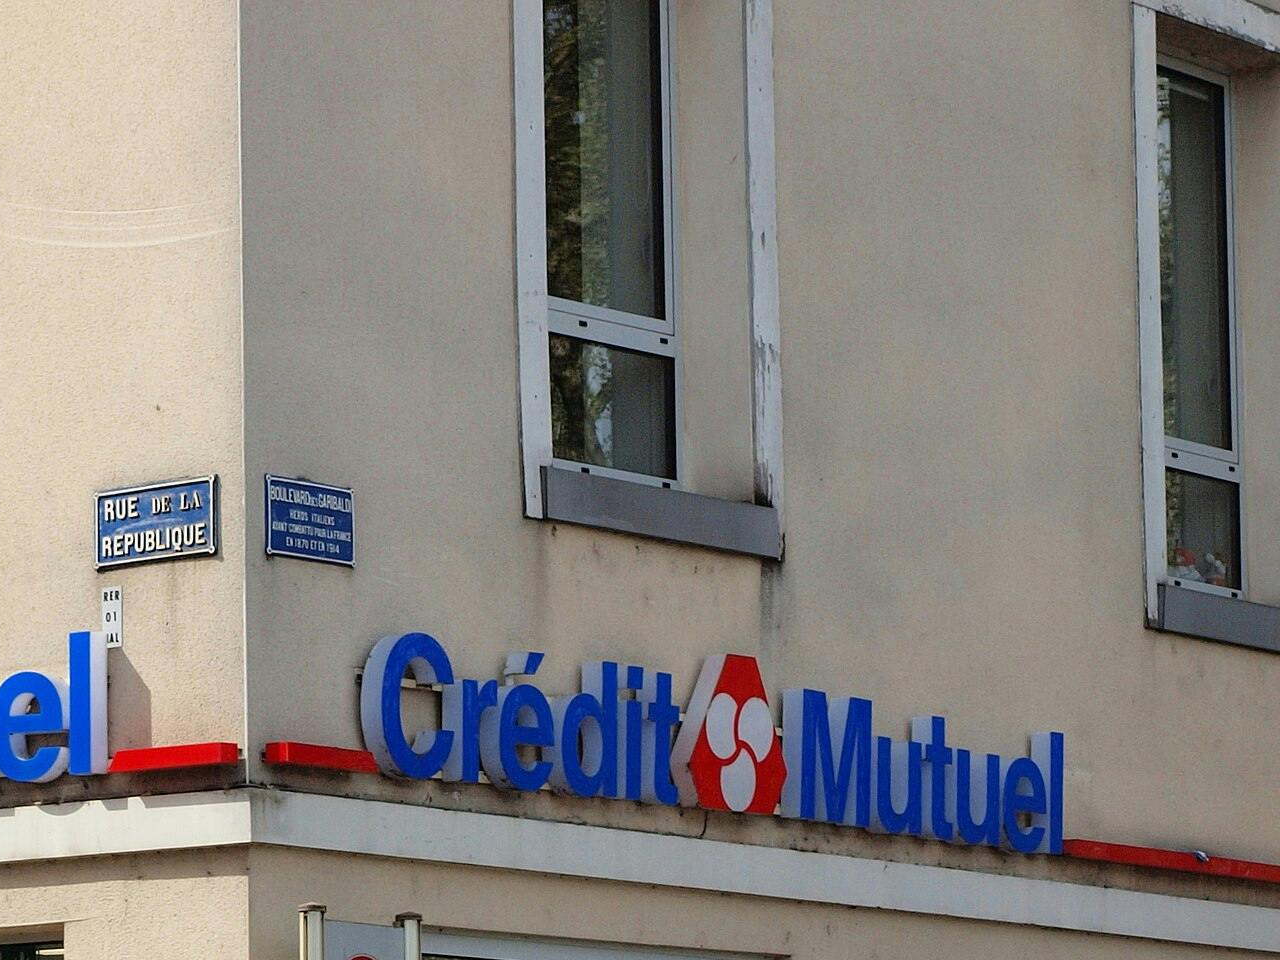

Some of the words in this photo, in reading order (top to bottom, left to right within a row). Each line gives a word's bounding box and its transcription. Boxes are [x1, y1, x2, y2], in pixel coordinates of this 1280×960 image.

[104, 497, 138, 521] RUE
[151, 495, 172, 515] DE
[179, 490, 202, 510] LA
[270, 485, 310, 505] BOULEVARD
[319, 494, 352, 512] GARIBALDI
[104, 590, 120, 601] RER
[365, 632, 680, 806] Crédit
[788, 689, 1065, 855] Mutuel
